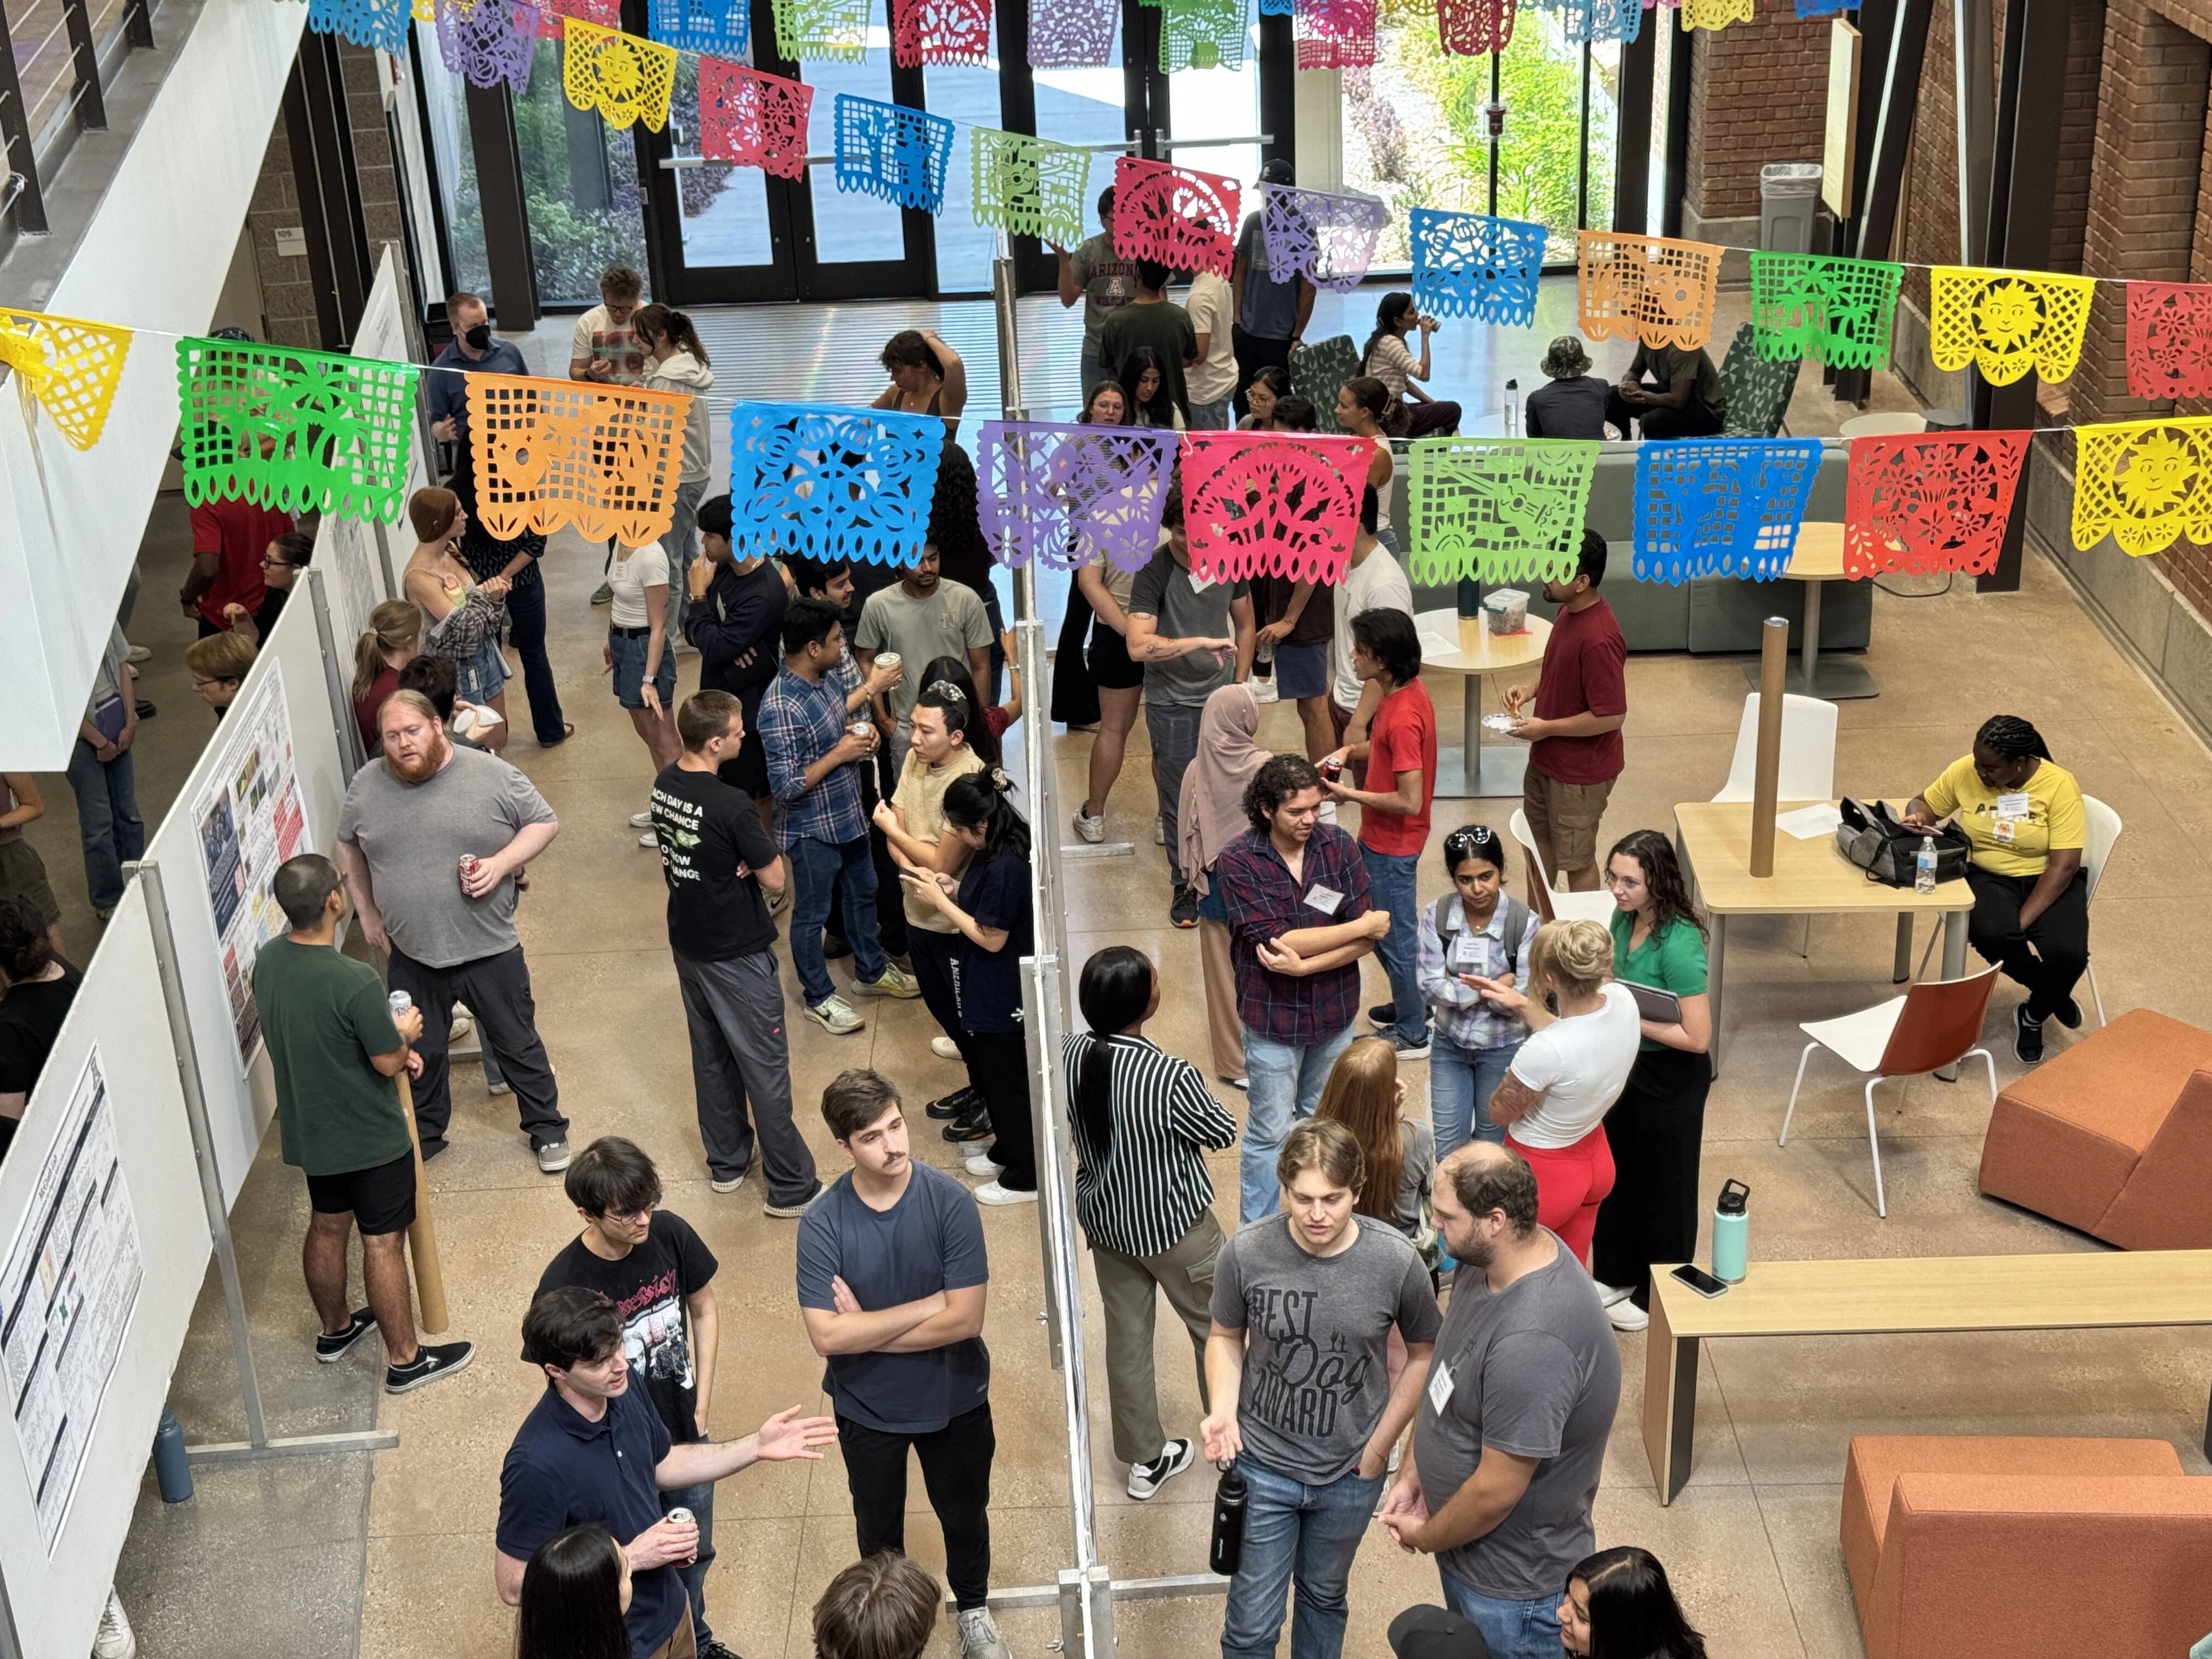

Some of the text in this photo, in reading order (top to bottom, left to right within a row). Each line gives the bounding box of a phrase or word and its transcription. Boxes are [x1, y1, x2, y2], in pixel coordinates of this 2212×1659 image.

[1106, 277, 1125, 296] A
[651, 787, 703, 818] ACH DAY IS A
[651, 801, 699, 831] EW CHANCE
[661, 844, 669, 854] O
[1247, 1289, 1318, 1345] BEST
[1267, 1335, 1372, 1406] Dog
[1249, 1368, 1338, 1437] AWARD
